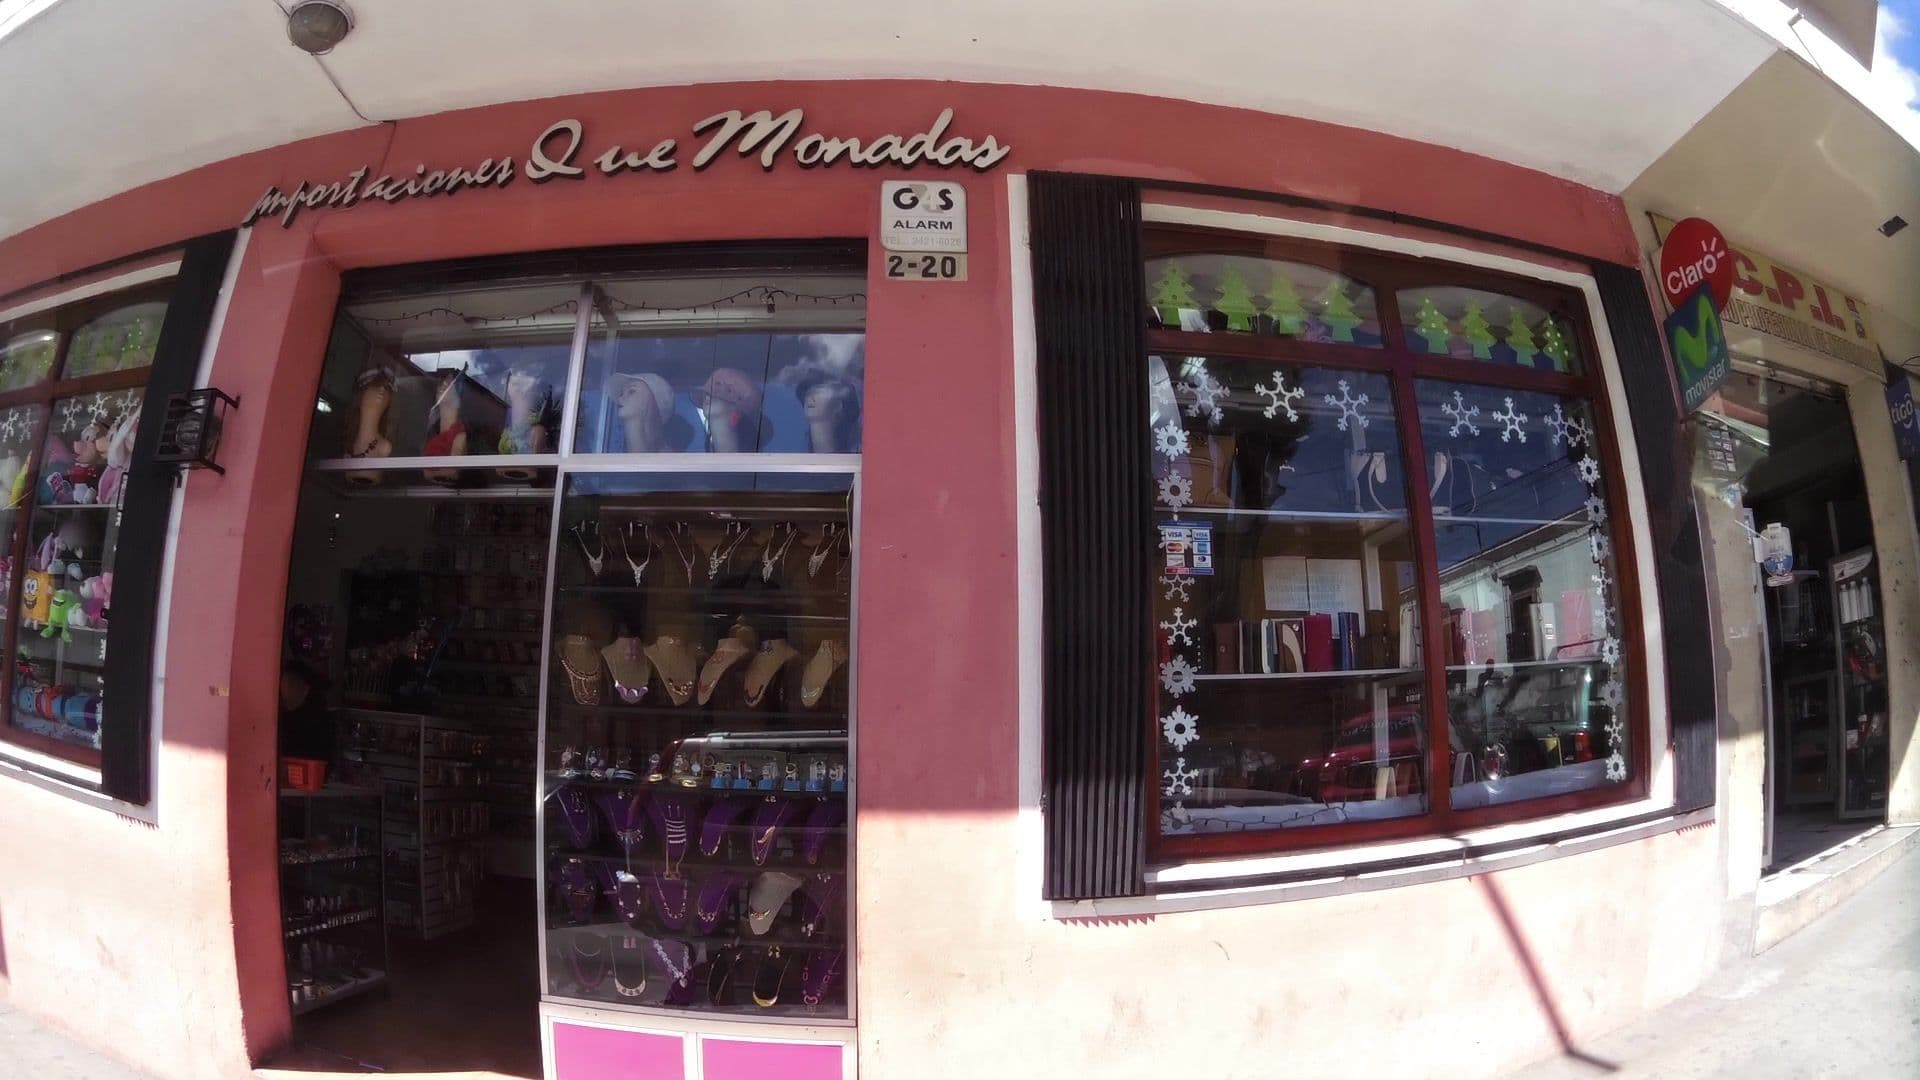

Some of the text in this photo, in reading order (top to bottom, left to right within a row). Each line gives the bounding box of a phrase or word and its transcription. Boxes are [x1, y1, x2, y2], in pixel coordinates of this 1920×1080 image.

[525, 118, 678, 183] Que
[692, 107, 1011, 171] Monadas
[893, 220, 953, 230] ALARM
[888, 255, 957, 278] 2-20
[1666, 253, 1718, 295] Claro
[1685, 358, 1727, 404] movistar
